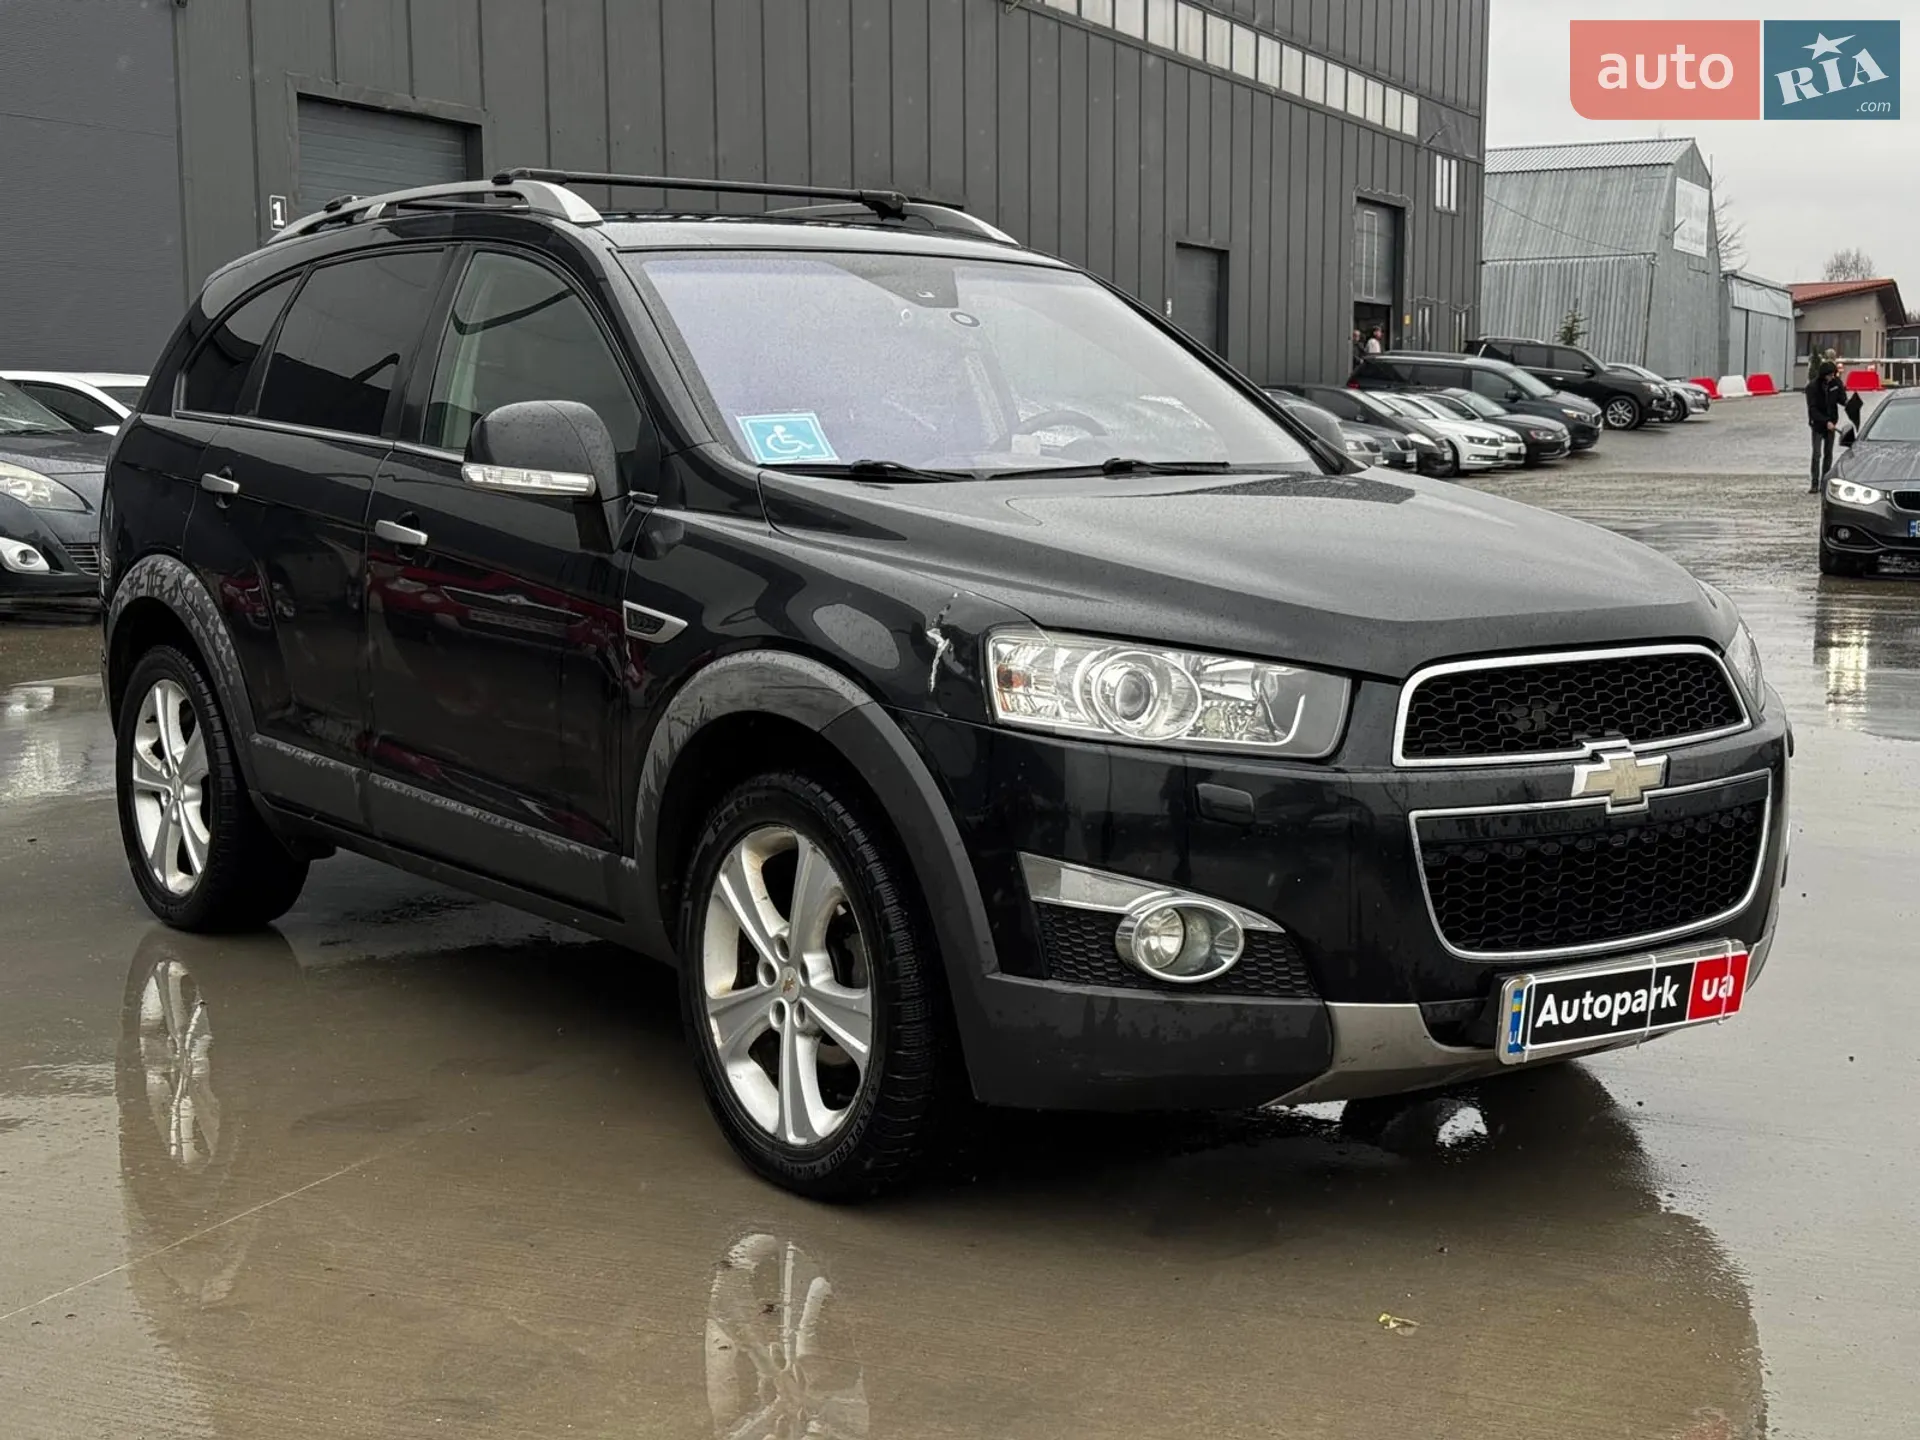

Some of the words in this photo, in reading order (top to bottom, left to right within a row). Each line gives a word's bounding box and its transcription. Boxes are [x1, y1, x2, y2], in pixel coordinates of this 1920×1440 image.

[272, 201, 285, 226] 1
[1534, 975, 1680, 1029] Autopark
[1701, 974, 1735, 1002] ua
